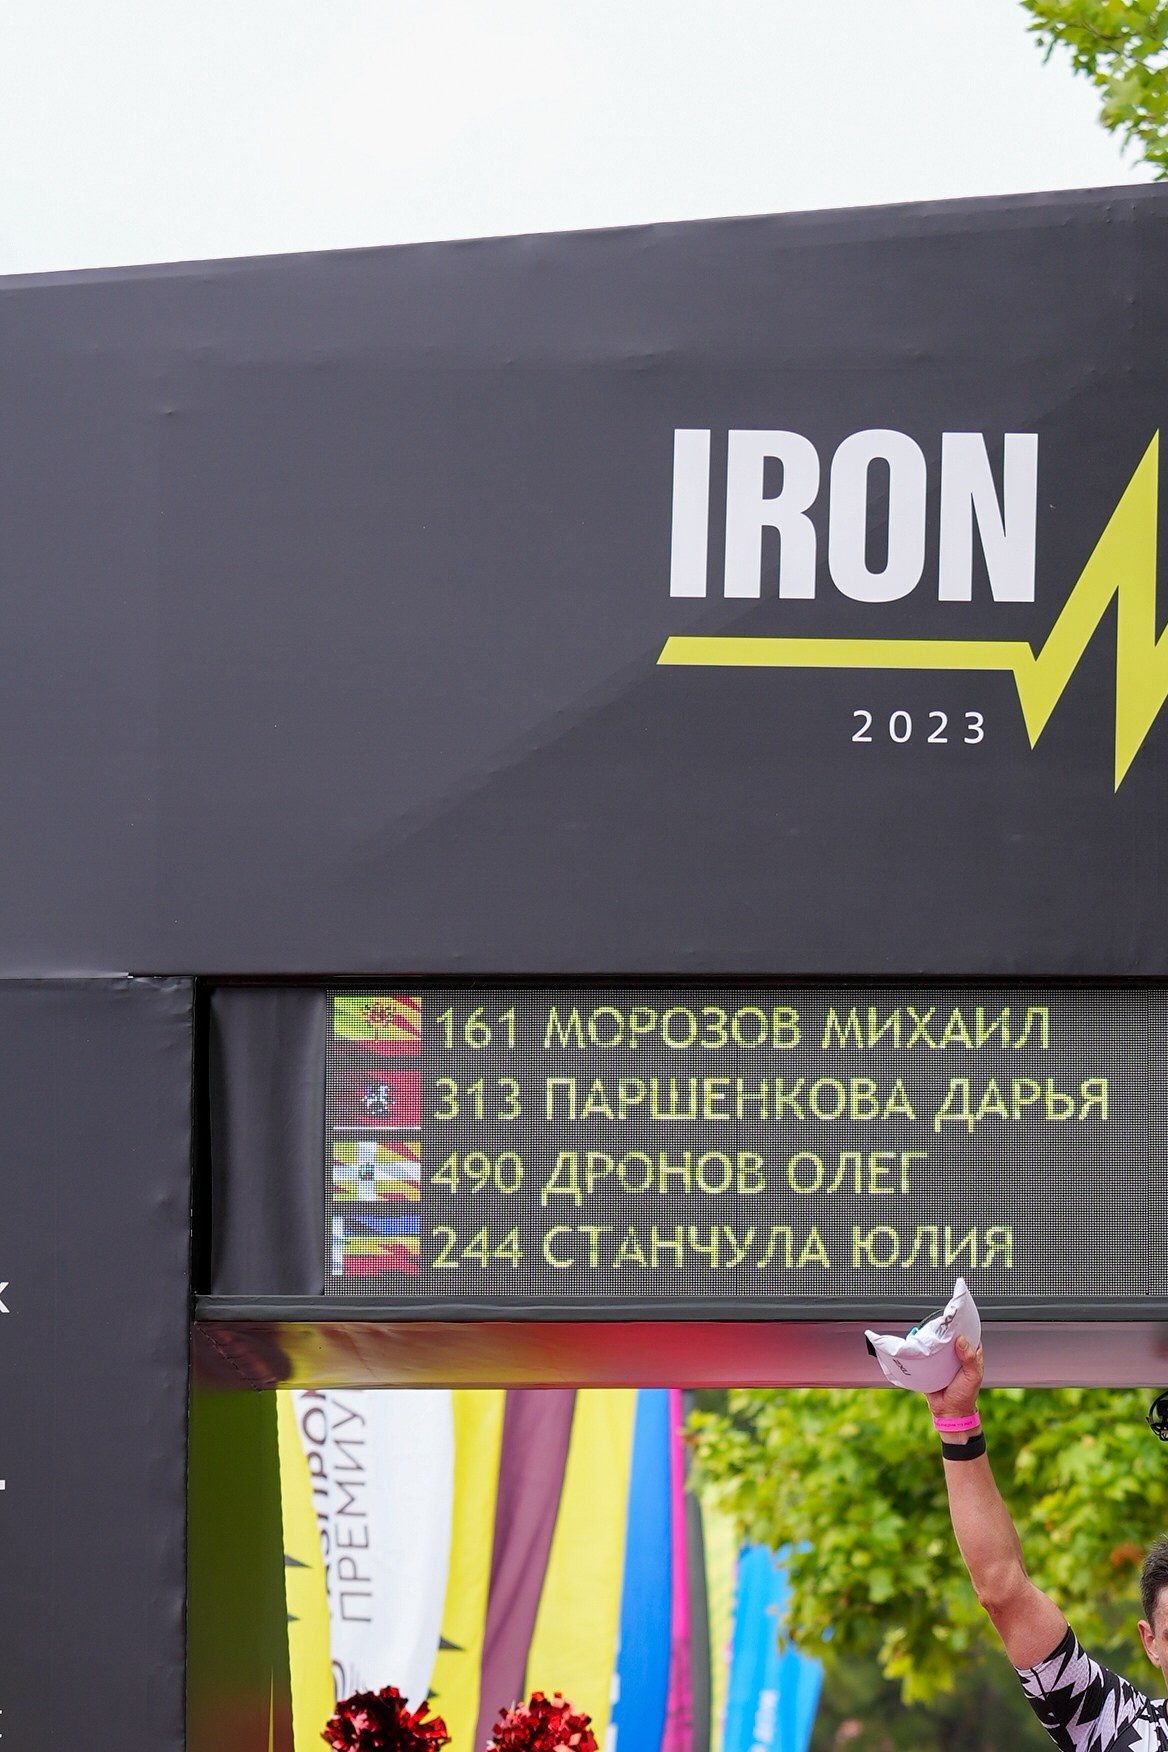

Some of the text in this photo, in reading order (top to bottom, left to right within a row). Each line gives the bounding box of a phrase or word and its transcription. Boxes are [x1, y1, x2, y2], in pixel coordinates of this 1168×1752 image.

[669, 428, 1038, 603] IRON
[851, 709, 984, 744] 2023
[436, 1006, 1049, 1048] 161 МОРОЗОВ МИХАИЛ
[434, 1077, 1110, 1132] 313 ПАРШЕНКОВА ДАРЬЯ
[431, 1150, 928, 1206] 490 ДРОНОВ ОЛЕГ
[432, 1225, 1014, 1268] 244 СТАНЧУЛА ЮЛИЯ
[332, 1388, 373, 1623] ПРЕМИУ
